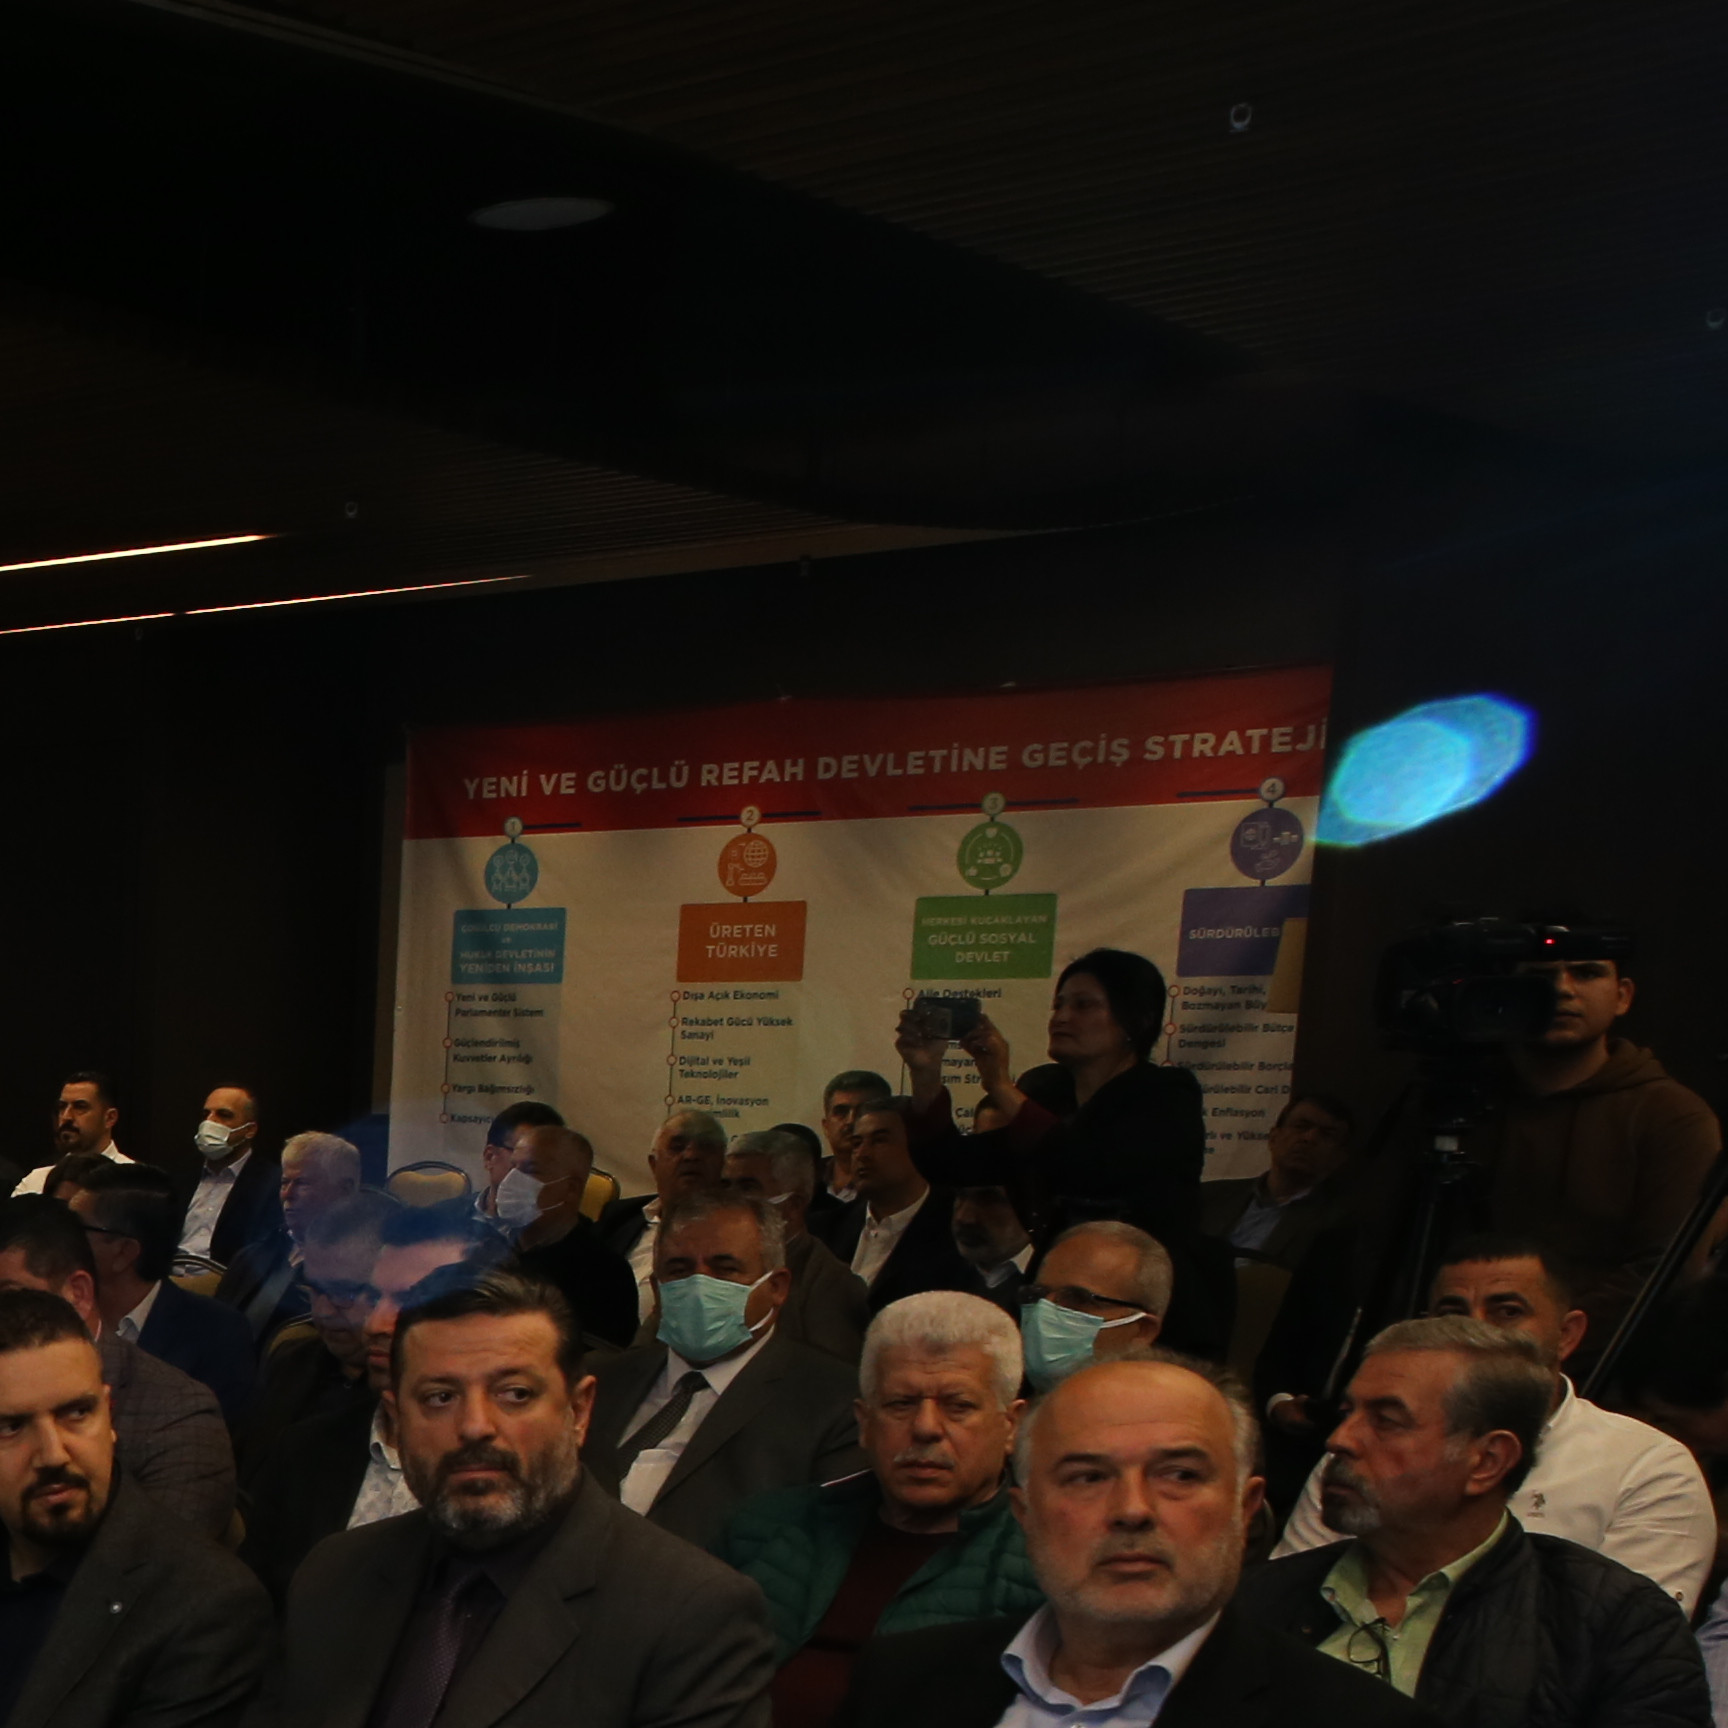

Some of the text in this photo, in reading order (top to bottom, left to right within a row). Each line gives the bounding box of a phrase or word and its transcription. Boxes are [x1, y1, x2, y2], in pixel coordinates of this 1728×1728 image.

[463, 769, 529, 800] YENİ
[539, 772, 577, 795] VE
[586, 758, 690, 795] GÜÇLÜ
[700, 757, 806, 787] REFAH
[816, 741, 1009, 781] DEVLETİNE
[1021, 733, 1131, 771] GEÇİŞ
[1265, 783, 1277, 796] 4
[746, 809, 755, 821] 2
[709, 921, 777, 939] ÜRETEN
[928, 930, 1037, 949] GÜÇLÜ SOSYAL
[705, 941, 779, 959] TÜRKİYE
[954, 950, 1010, 964] DEVLET
[733, 990, 779, 1000] Ekonomi
[712, 1058, 724, 1066] ve
